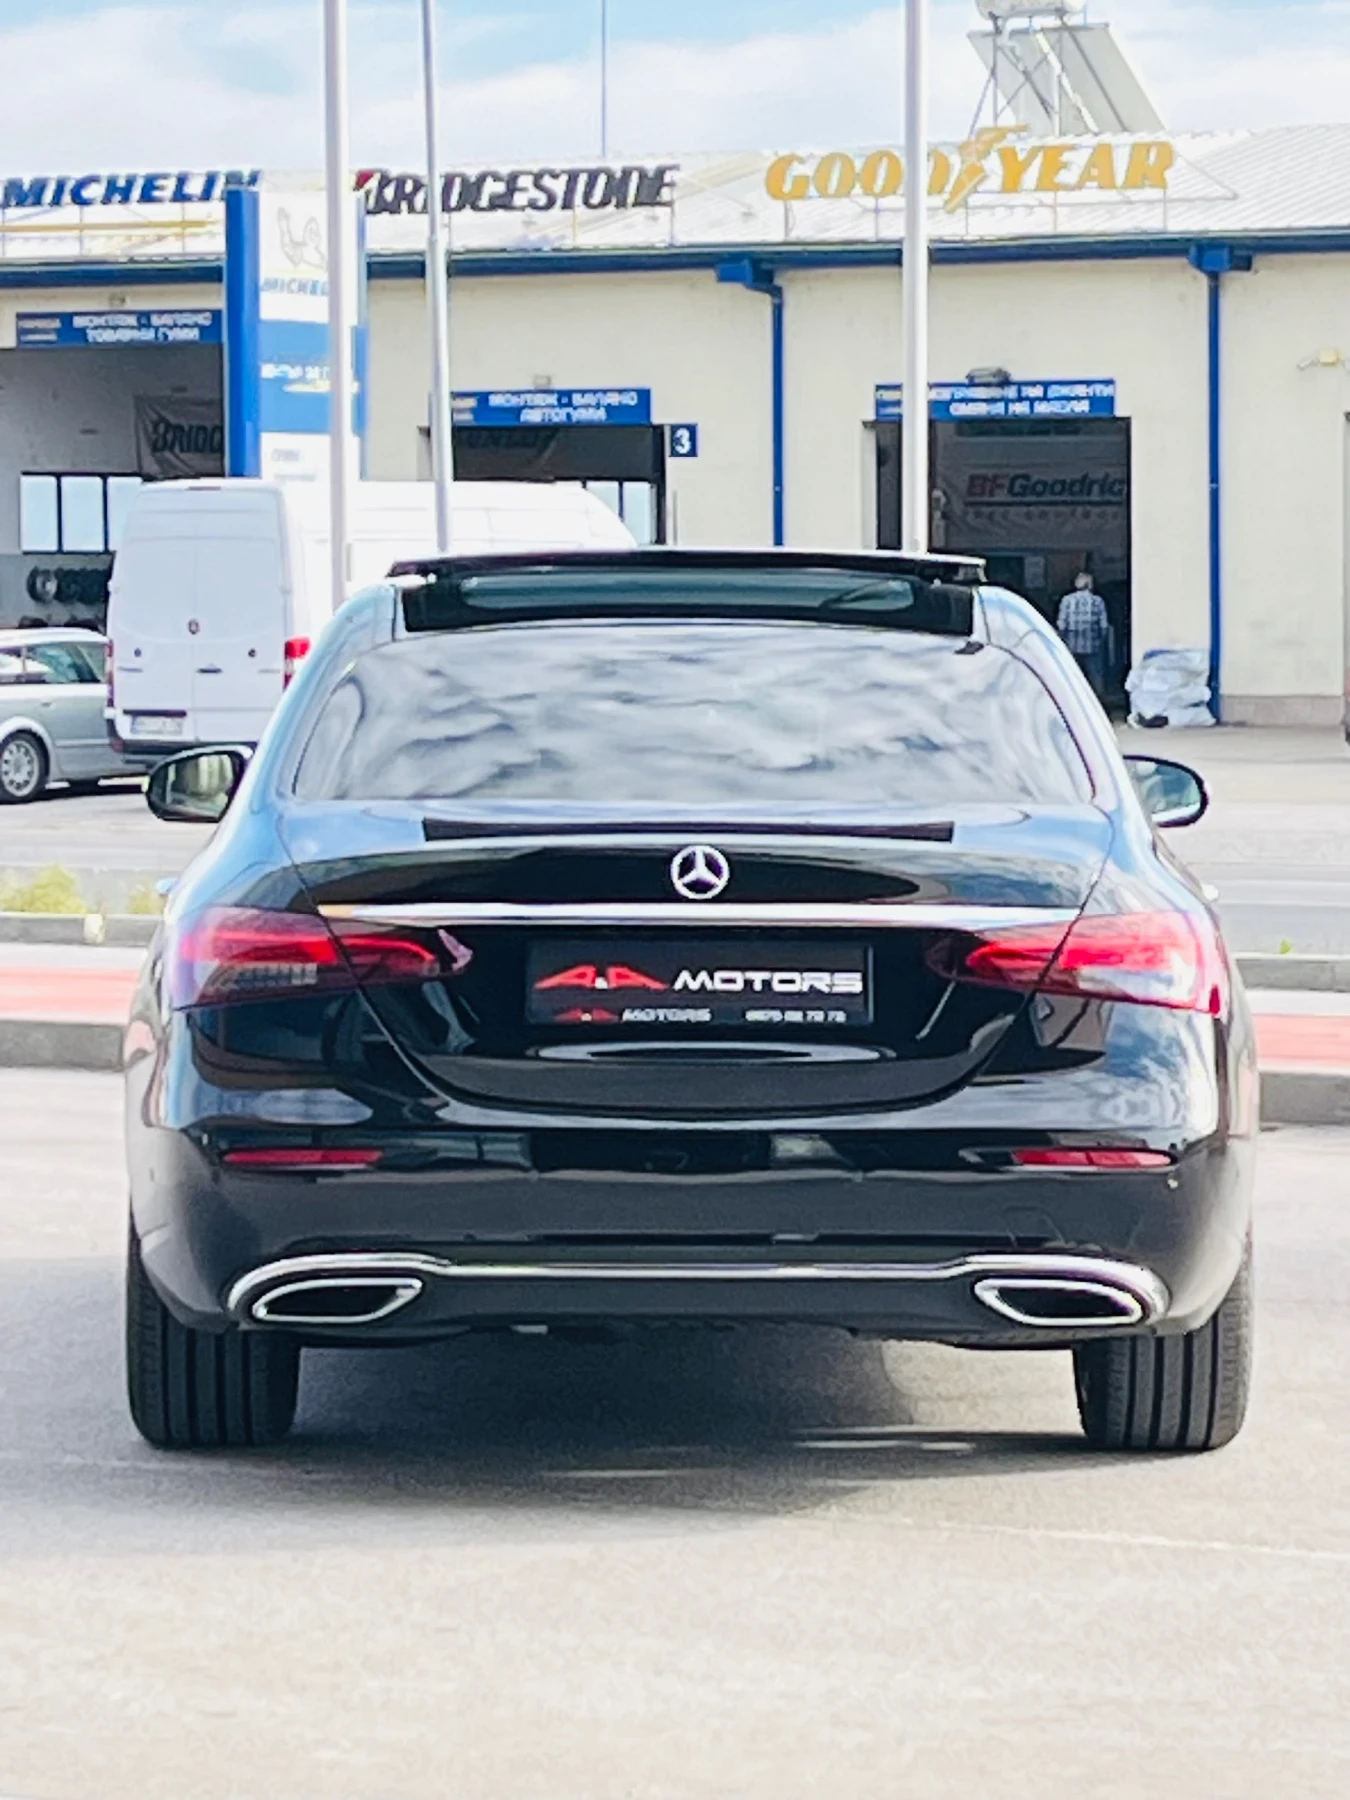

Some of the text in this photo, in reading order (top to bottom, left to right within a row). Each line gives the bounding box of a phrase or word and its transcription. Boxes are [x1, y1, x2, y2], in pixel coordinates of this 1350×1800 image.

[353, 165, 681, 214] BRDGESTONE
[673, 428, 692, 454] 3
[673, 970, 863, 993] MOTORS
